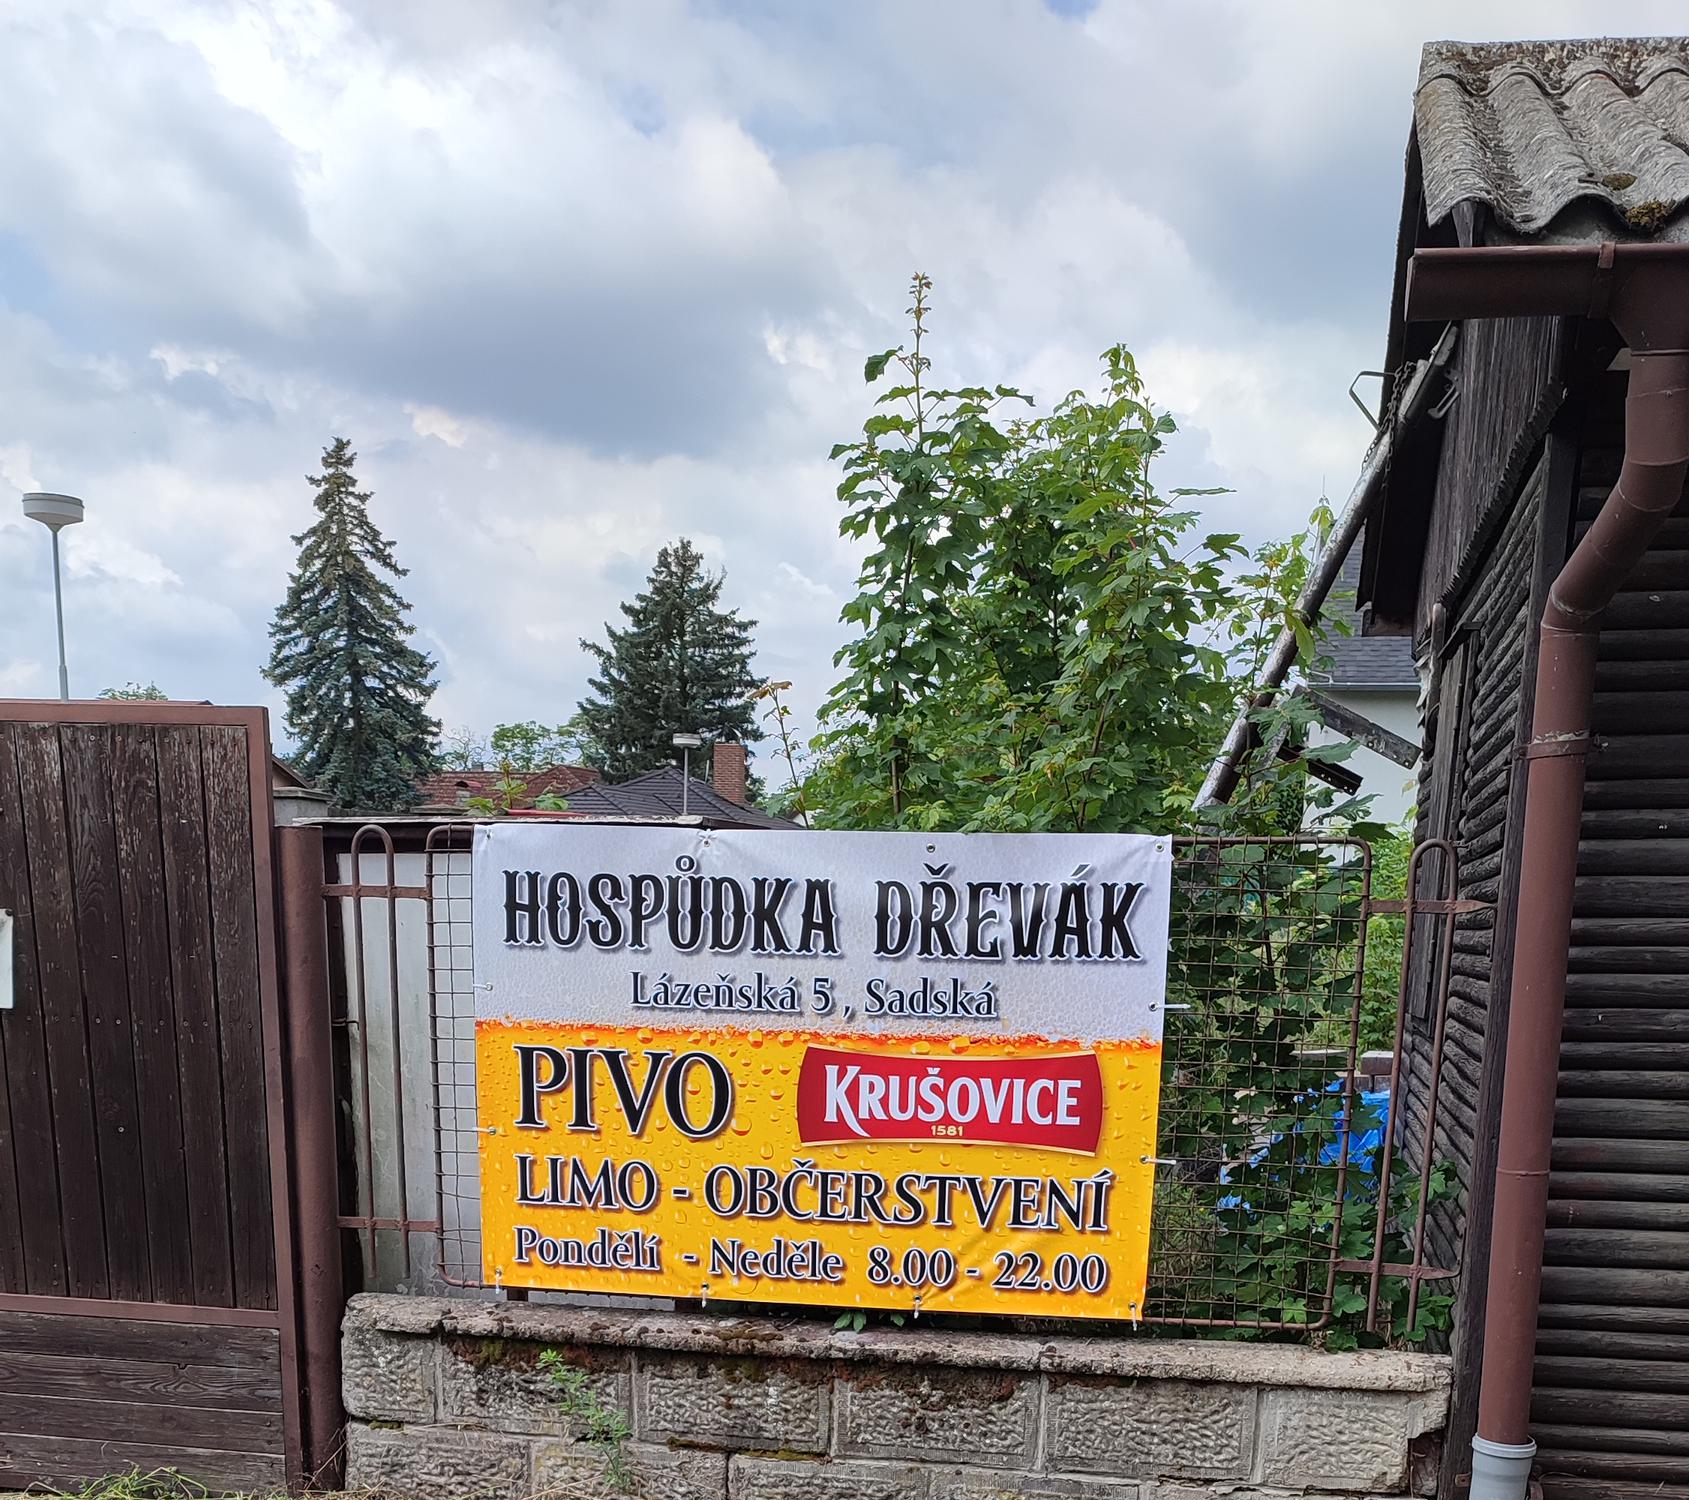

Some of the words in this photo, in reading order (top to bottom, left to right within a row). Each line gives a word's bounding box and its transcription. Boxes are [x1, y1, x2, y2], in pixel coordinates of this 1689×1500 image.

[502, 854, 840, 953] HOSPŮDKA
[873, 863, 1146, 962] DŘEVÁK
[629, 970, 798, 1012] Lázeňská
[864, 979, 999, 1018] Sadská
[514, 1045, 733, 1138] PIVO
[824, 1064, 1082, 1138] KRUŠOVICE
[931, 1124, 965, 1138] 1581
[514, 1153, 657, 1211] LIMO
[704, 1160, 1114, 1231] OBČERSTVENÍ
[513, 1226, 661, 1270] Pondělí
[709, 1238, 842, 1282] Neděle
[868, 1249, 954, 1288] 8.00
[992, 1251, 1107, 1293] 22.00
